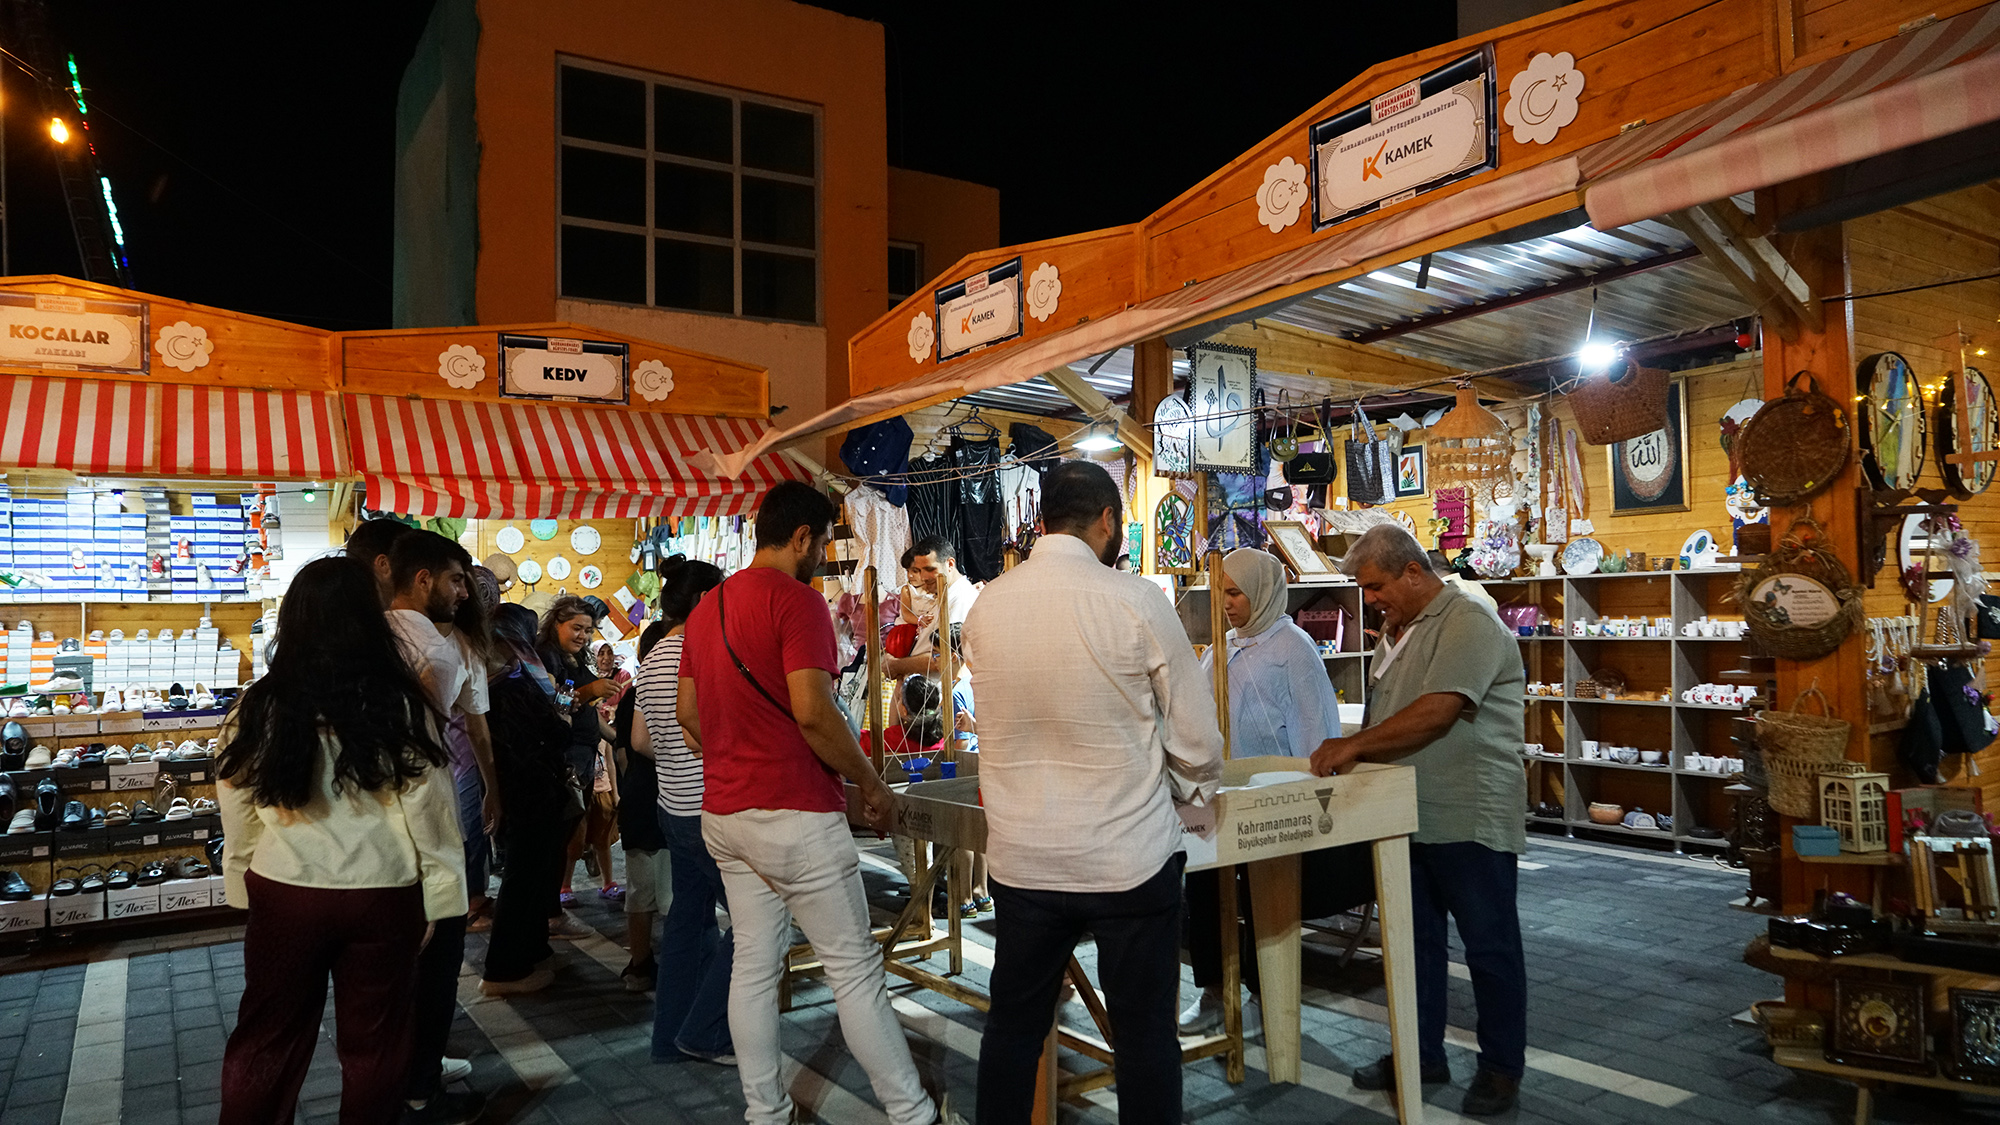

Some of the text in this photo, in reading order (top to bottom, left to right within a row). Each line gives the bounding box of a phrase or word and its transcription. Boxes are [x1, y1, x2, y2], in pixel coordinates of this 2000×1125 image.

[1385, 134, 1434, 165] KAMEK
[972, 309, 996, 325] KAMEK
[9, 324, 110, 345] KOCALAR
[34, 347, 87, 358] AYAKKABI
[543, 366, 588, 382] KEDV
[1181, 824, 1206, 834] KAMEK
[1237, 814, 1313, 836] Kahramanmaraş
[1238, 826, 1314, 851] Büyükşehir Belediyesi
[114, 902, 146, 917] Alex
[166, 896, 197, 910] Alex
[54, 910, 89, 925] Alex
